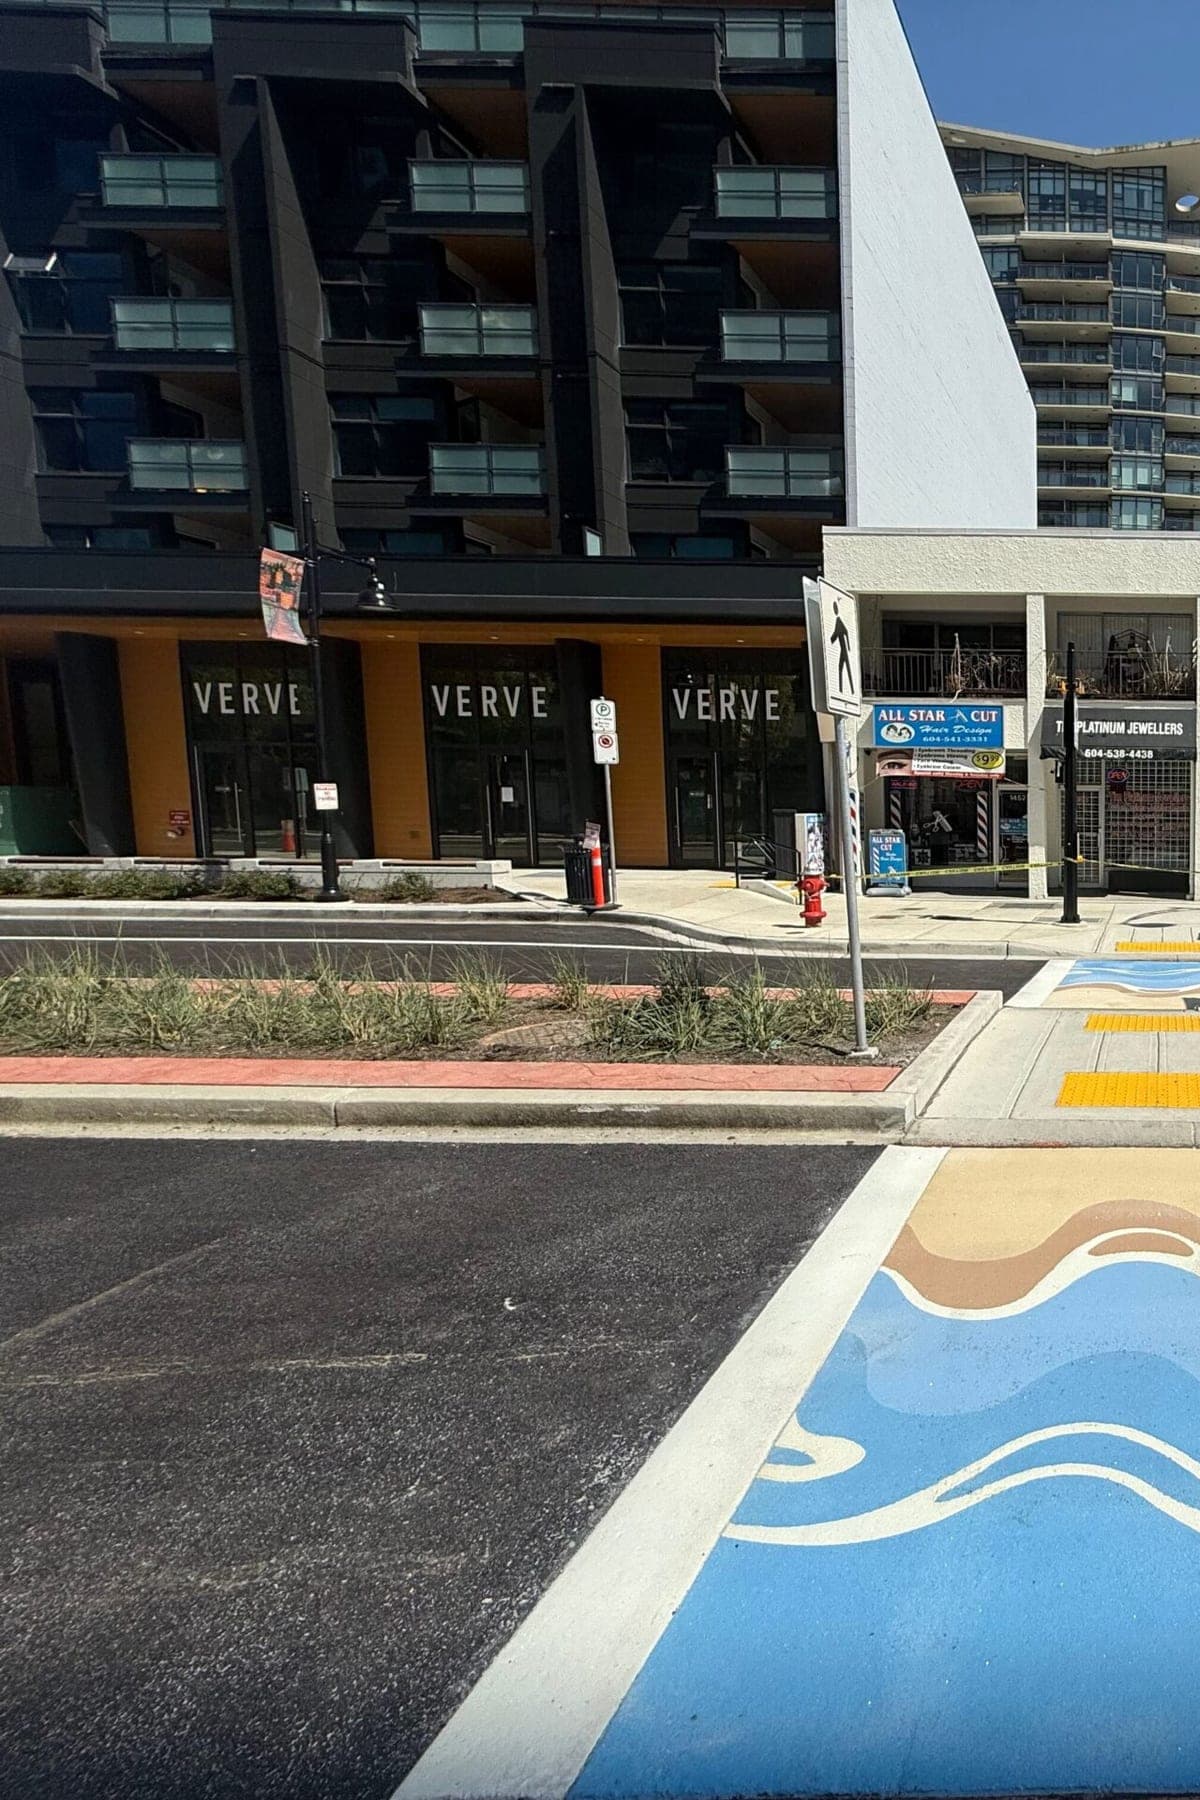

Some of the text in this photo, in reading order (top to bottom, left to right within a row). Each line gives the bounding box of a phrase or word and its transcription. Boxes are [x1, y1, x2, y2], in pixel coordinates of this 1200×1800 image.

[193, 682, 301, 715] VERVE
[431, 685, 548, 718] VERVE
[672, 688, 780, 721] VERVE
[879, 709, 999, 722] ALL STAR CUT
[919, 724, 993, 735] Hair Design
[1126, 722, 1184, 736] JEWELLERS
[1084, 748, 1154, 759] 604-538-4438
